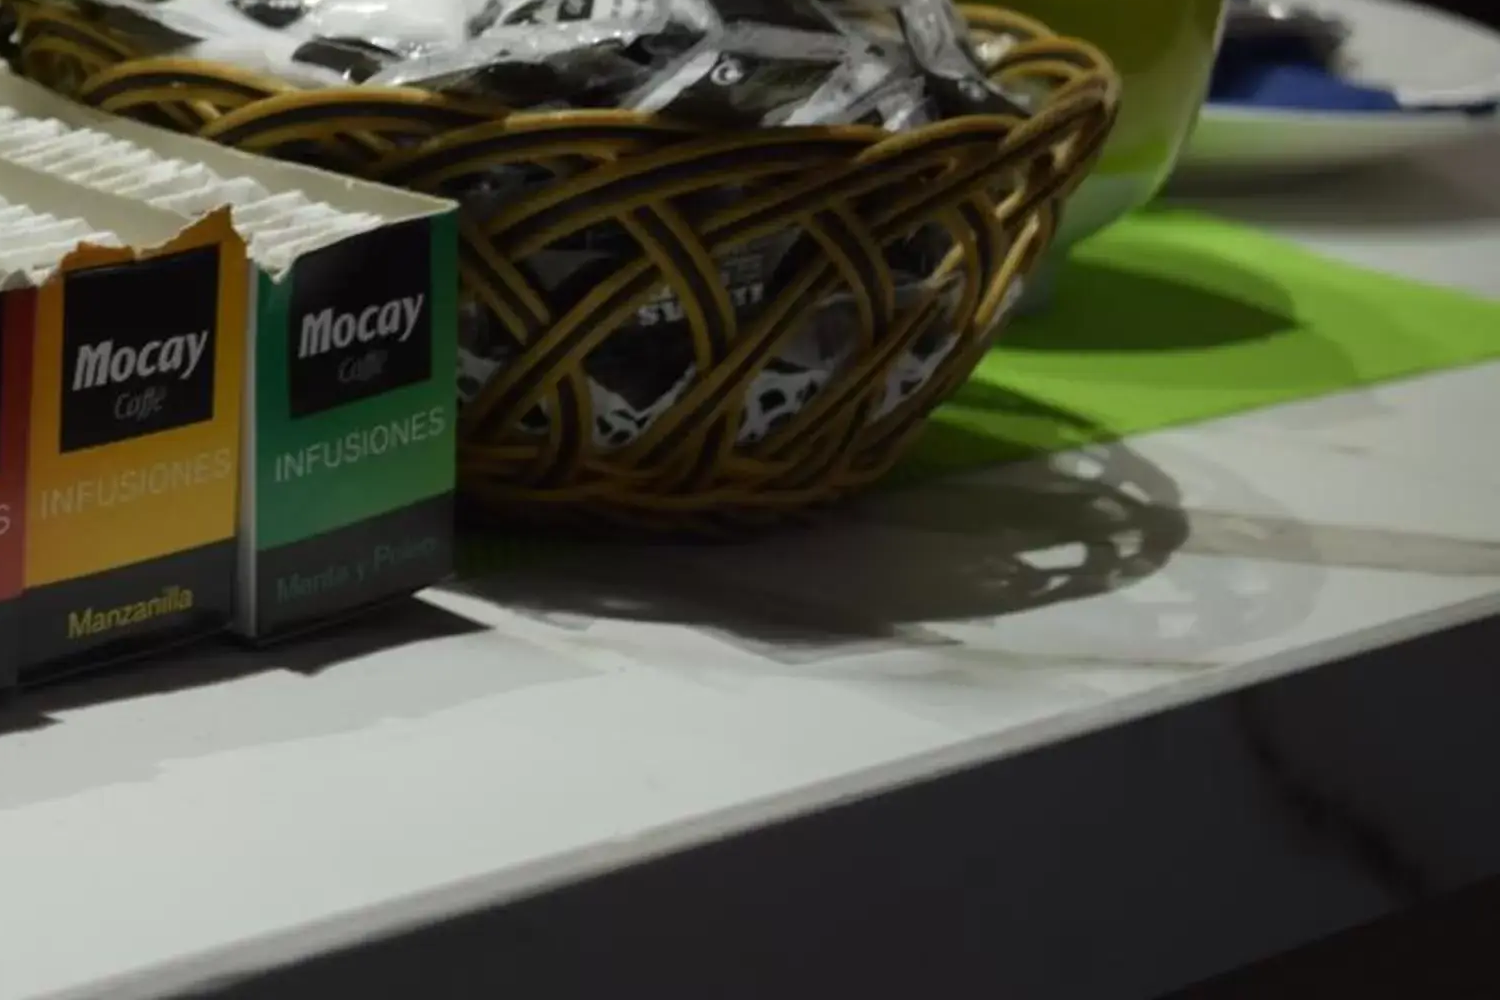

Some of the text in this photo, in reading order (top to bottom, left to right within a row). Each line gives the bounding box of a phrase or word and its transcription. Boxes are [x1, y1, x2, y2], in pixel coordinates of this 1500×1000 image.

[298, 292, 424, 360] Mocay
[71, 329, 209, 393] Mocay
[274, 406, 447, 484] INFUSIONES
[40, 448, 233, 521] INFUSIONES
[67, 585, 195, 640] Manzanilla
